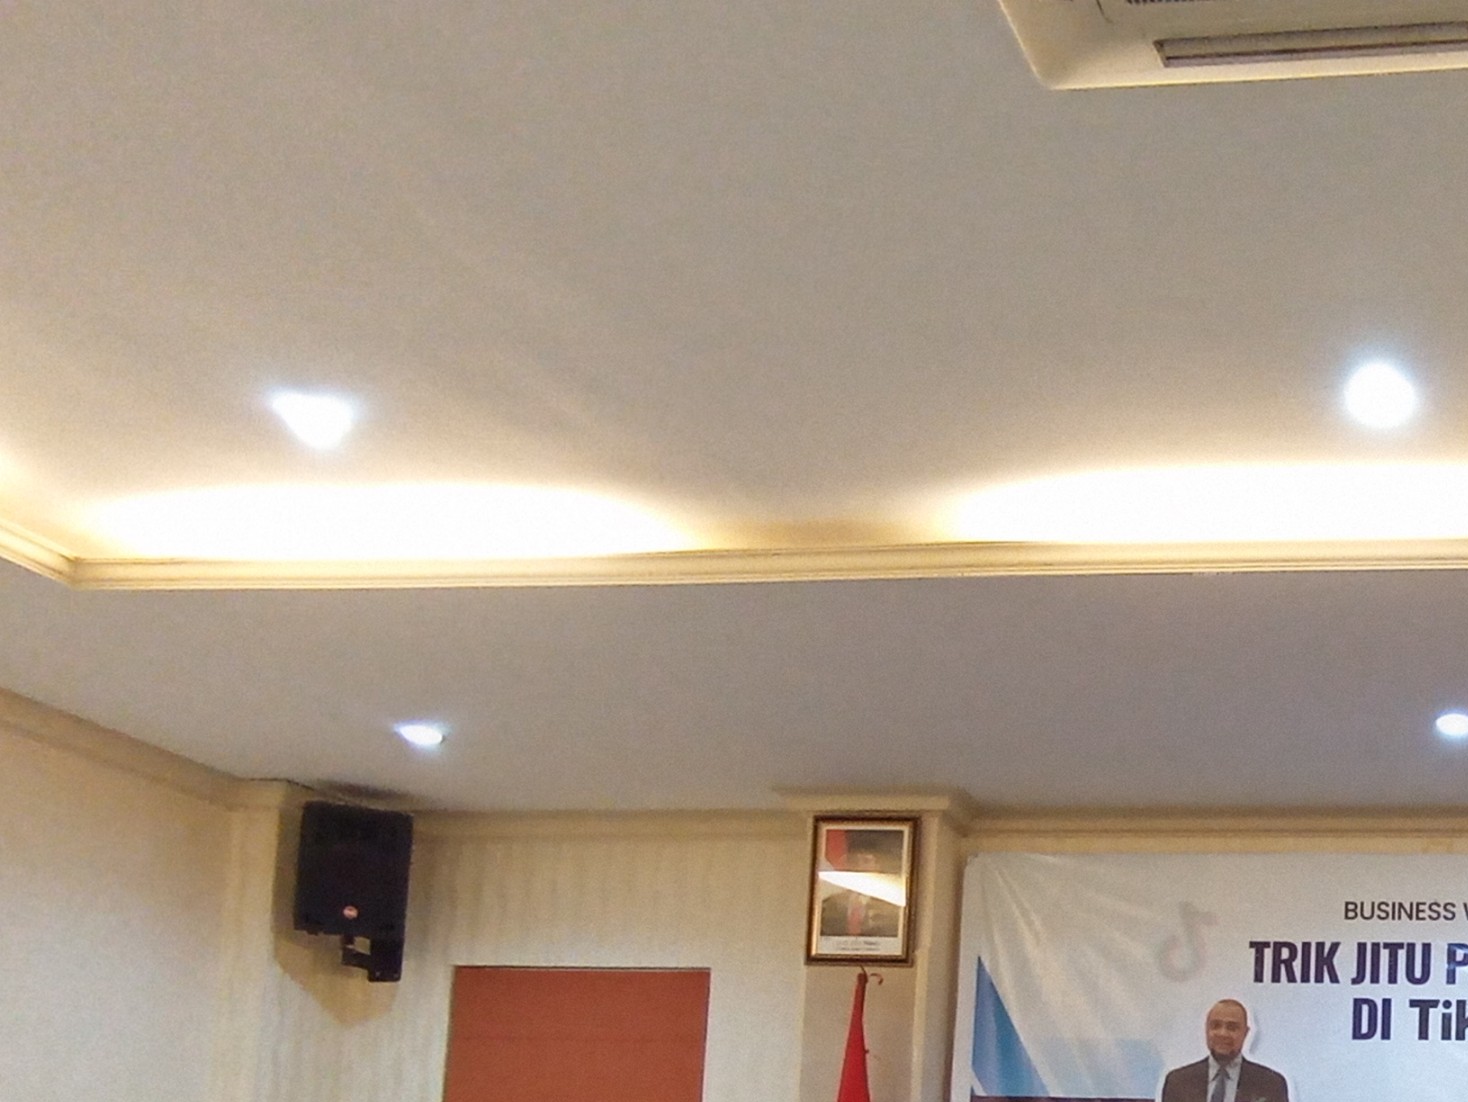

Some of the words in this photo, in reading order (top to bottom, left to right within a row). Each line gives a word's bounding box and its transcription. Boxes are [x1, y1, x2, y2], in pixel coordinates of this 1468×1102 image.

[1343, 901, 1457, 921] BUSINESS
[1249, 941, 1342, 984] TRIK
[1351, 942, 1432, 986] JITU
[1351, 998, 1391, 1041] DI
